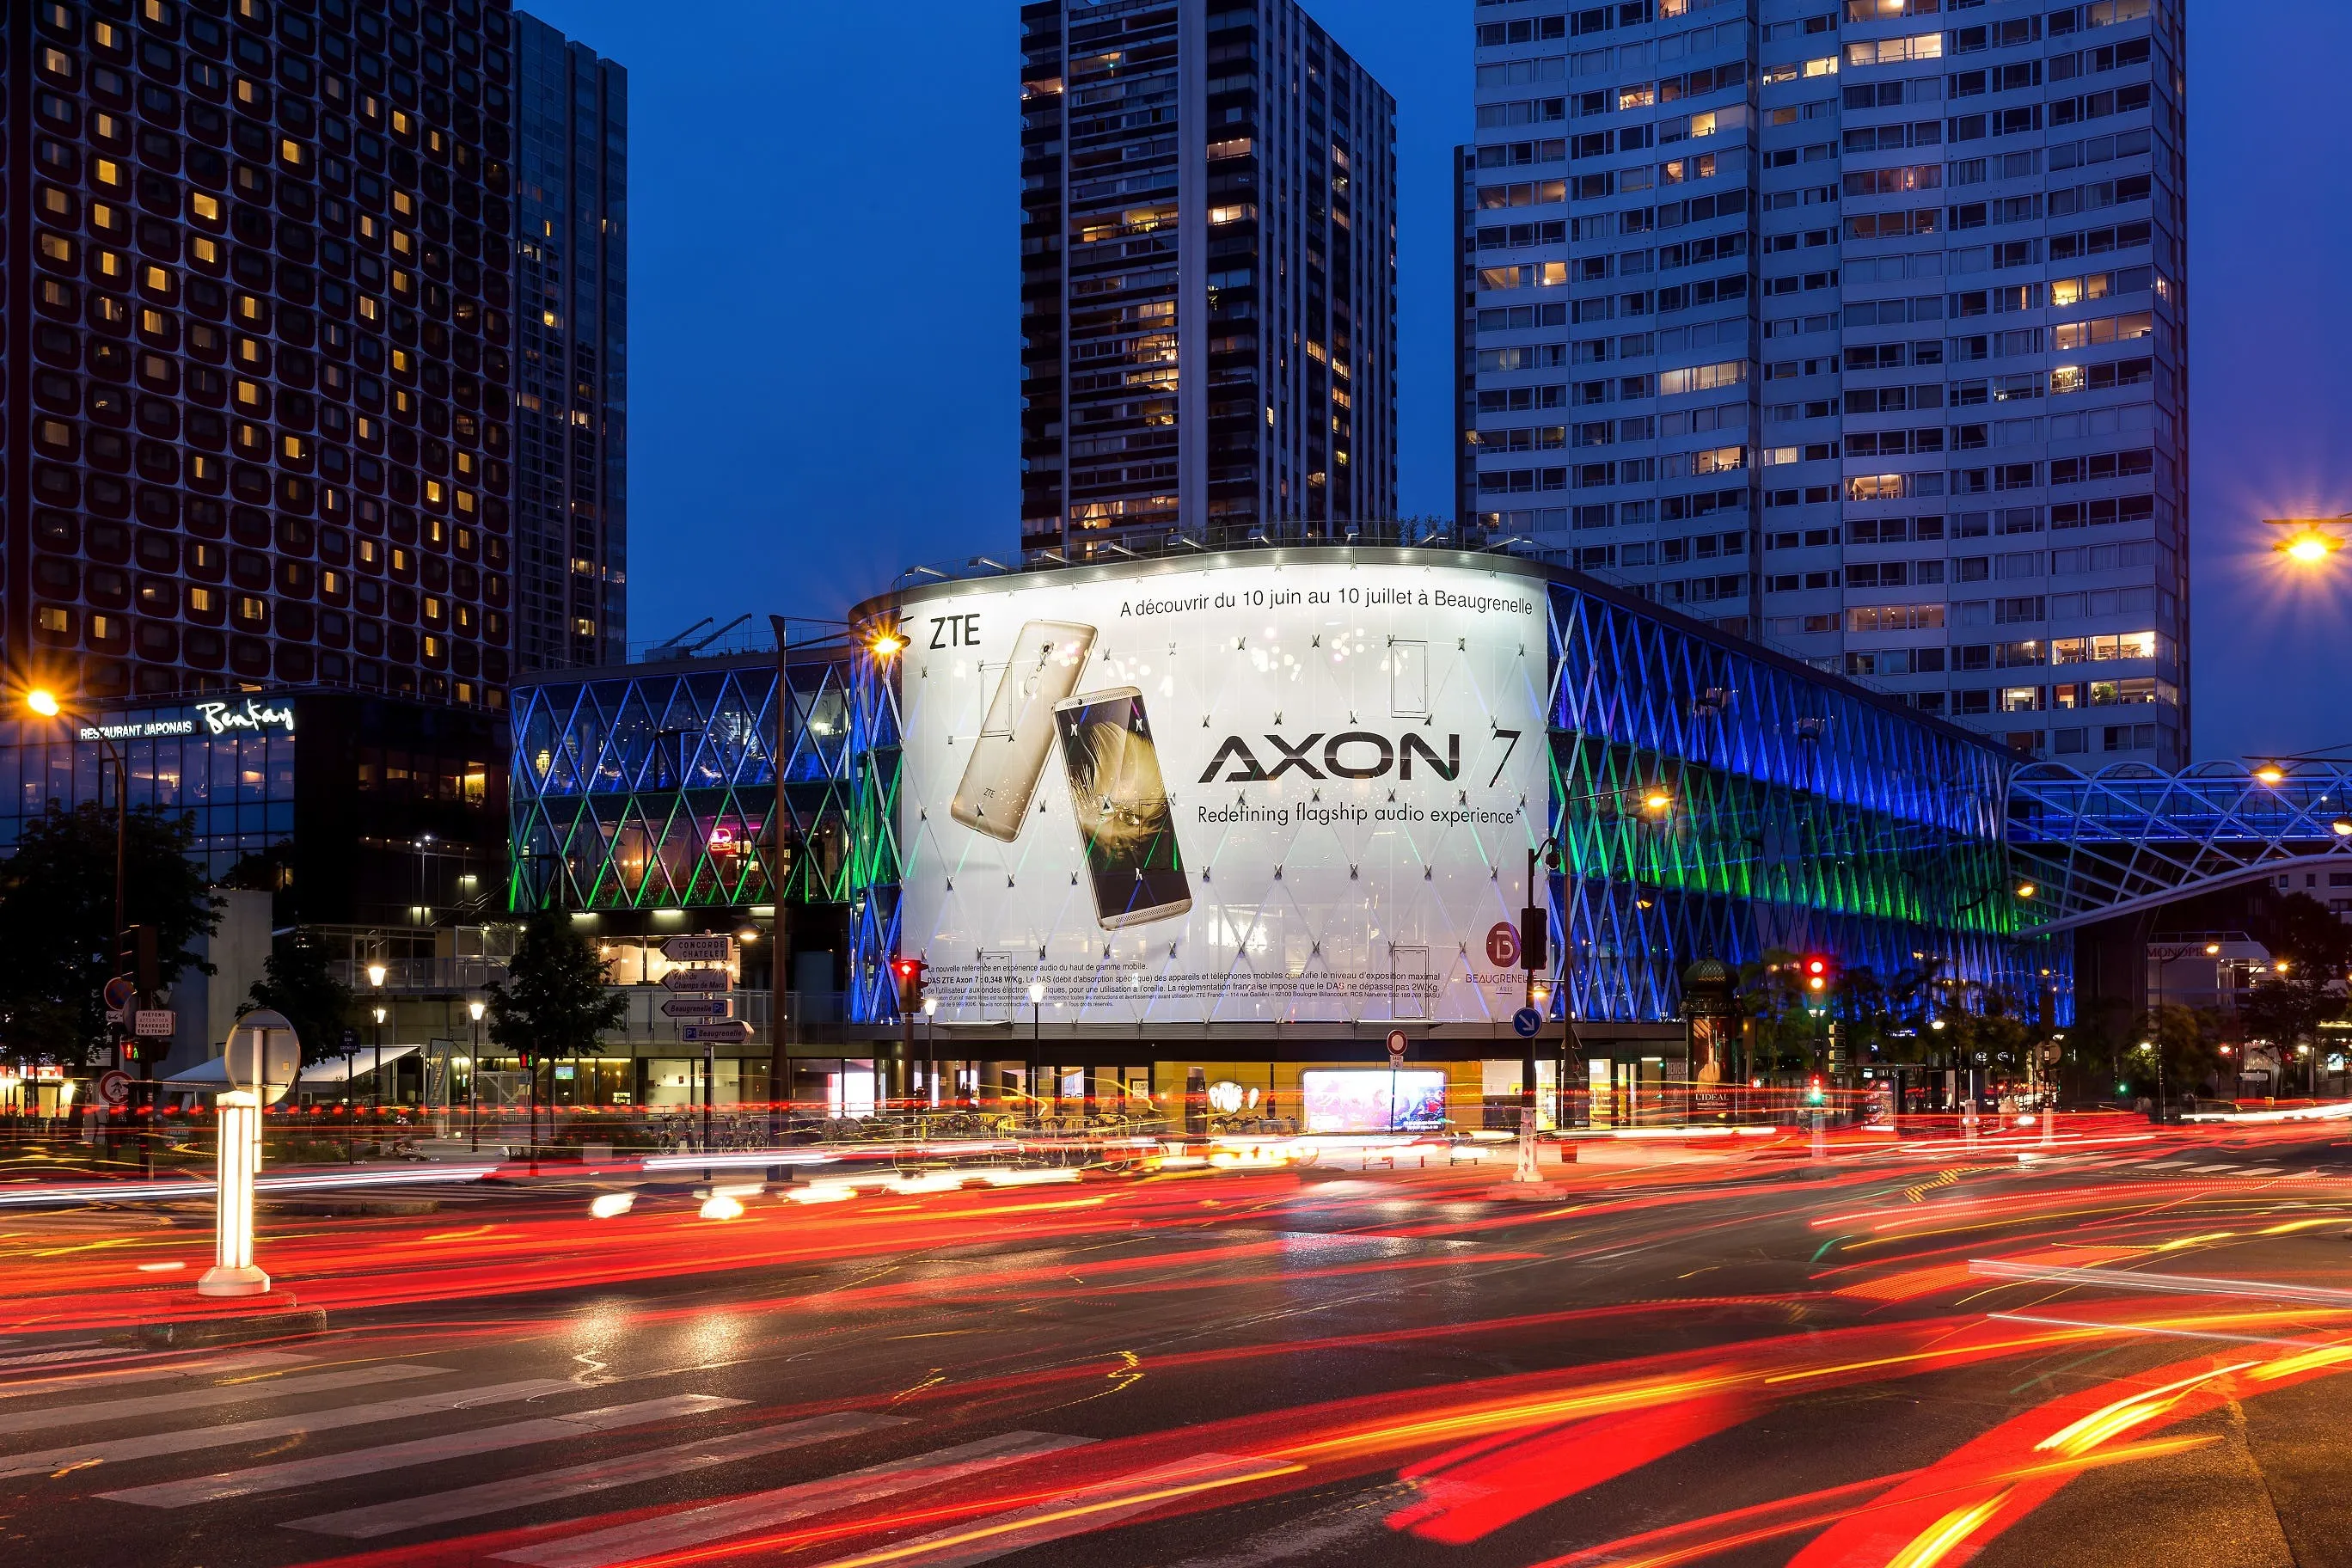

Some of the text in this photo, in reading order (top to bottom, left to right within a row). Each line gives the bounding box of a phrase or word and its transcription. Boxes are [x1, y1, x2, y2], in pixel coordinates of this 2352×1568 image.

[1120, 587, 1533, 617] A découvrir du 10 juin au 10 juillet à Beaugrenelle
[930, 614, 980, 649] ZTE
[80, 720, 193, 739] RESTAURANT JAPONAIS
[1197, 729, 1522, 787] AXON 7
[983, 787, 995, 798] ZTE
[1198, 804, 1289, 825] Redefining
[1296, 802, 1368, 825] flagship
[1375, 802, 1424, 821] audio
[2147, 947, 2215, 957] MONOPR
[1096, 964, 1120, 972] gamme
[1123, 962, 1148, 971] mobile.
[984, 976, 1002, 984] 0,348
[1004, 976, 1025, 984] W/Kg.
[1052, 975, 1072, 983] (débit
[1073, 975, 1114, 984] d'absorption
[1168, 973, 1199, 982] appareils
[1210, 972, 1252, 982] téléphones
[1285, 971, 1319, 980] quantifie
[1359, 971, 1406, 981] d'exposition
[1466, 973, 1537, 983] BEAUGRENELE
[1178, 983, 1231, 993] réglementation
[1233, 983, 1267, 992] française
[1270, 983, 1297, 991] impose
[1359, 983, 1393, 992] dépasse
[1395, 984, 1410, 993] pas
[671, 1004, 712, 1013] Beaugrenelle
[699, 1028, 742, 1038] Beaugrenelle
